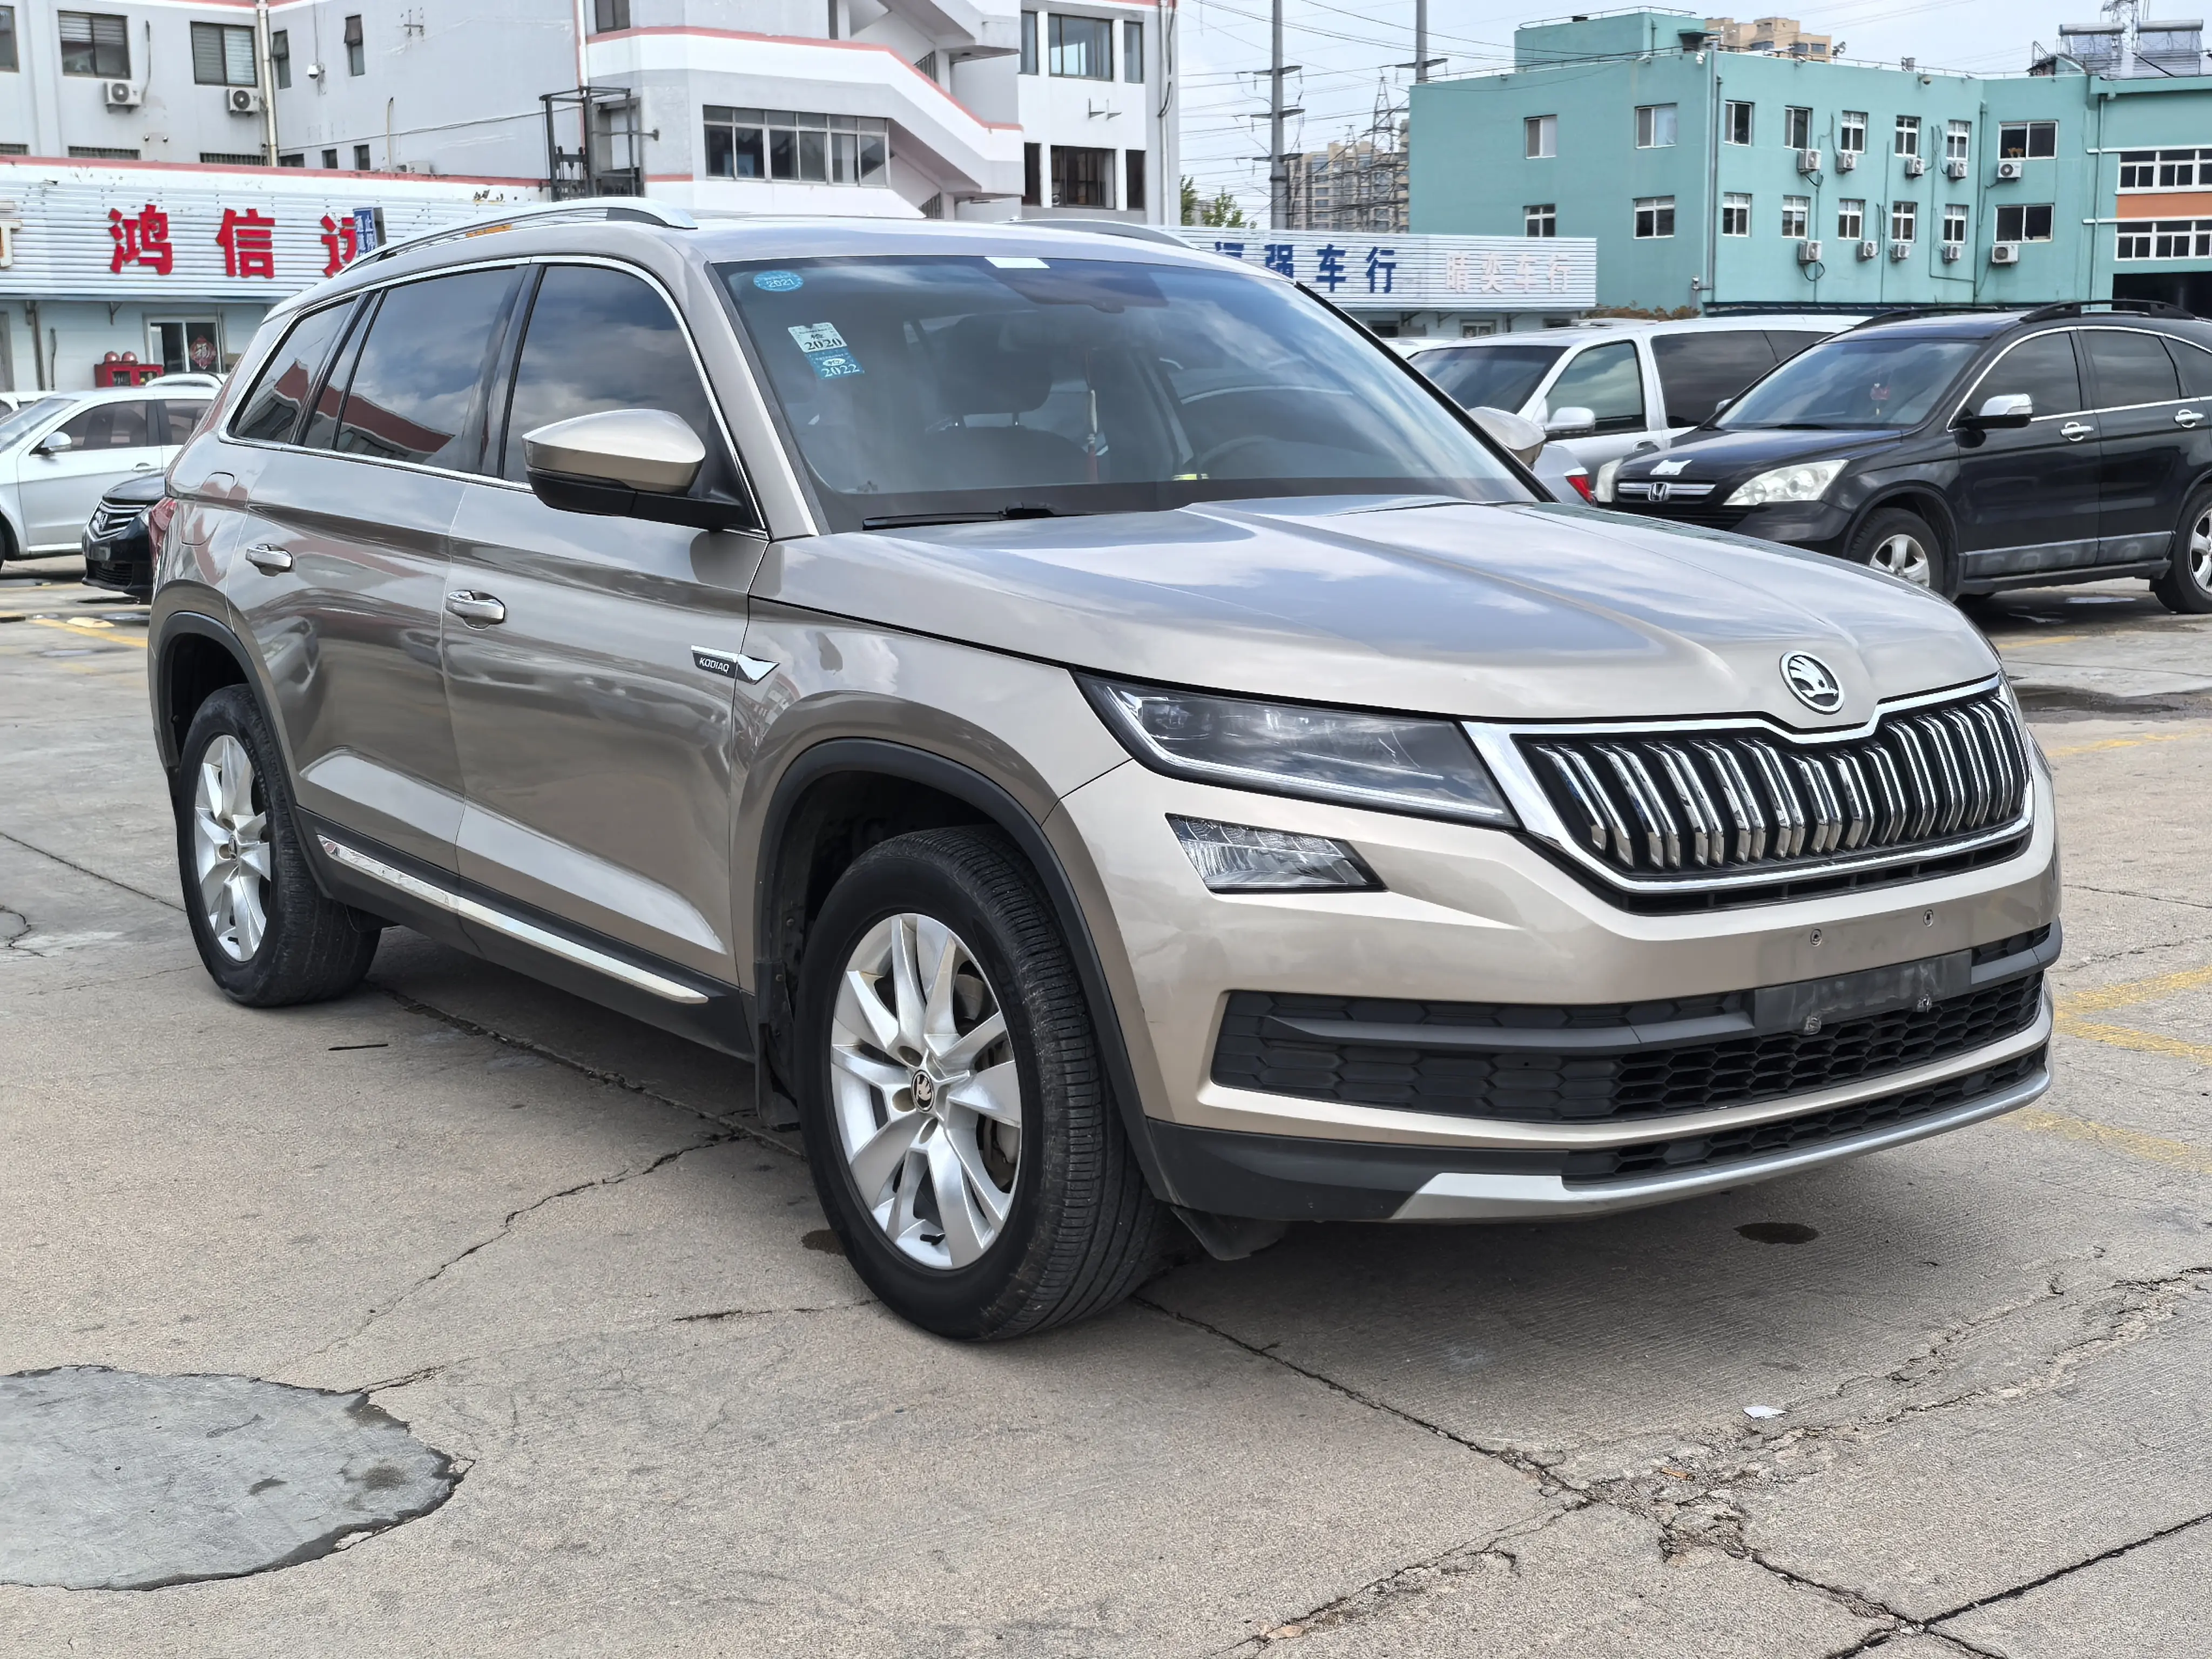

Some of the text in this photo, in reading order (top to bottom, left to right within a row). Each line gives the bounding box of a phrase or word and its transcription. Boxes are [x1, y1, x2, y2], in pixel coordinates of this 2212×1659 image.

[1215, 241, 1397, 293] 强车行
[804, 338, 842, 350] 2020
[821, 363, 860, 377] 2022
[699, 657, 729, 674] KODIAQ
